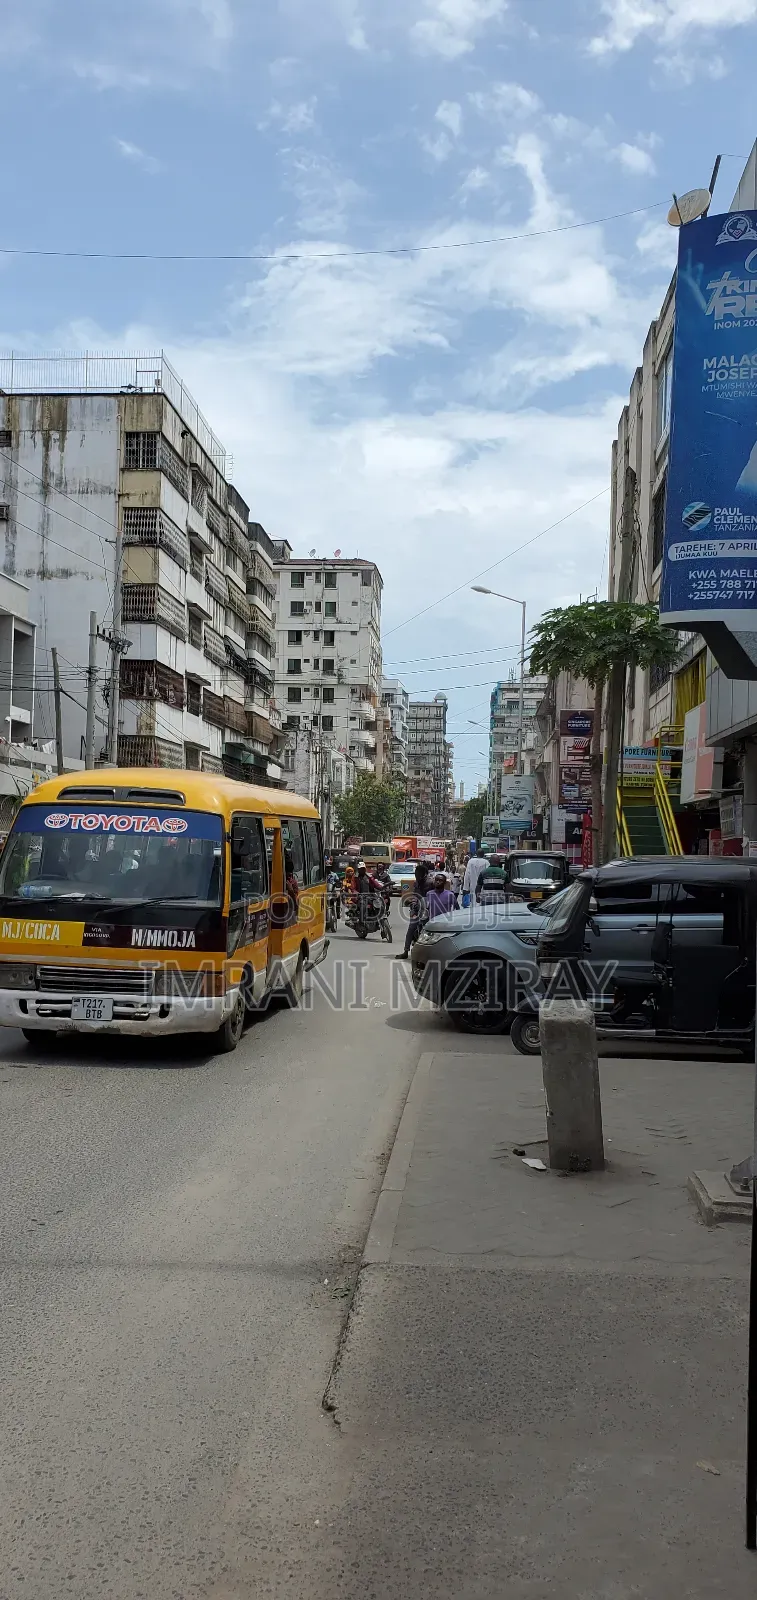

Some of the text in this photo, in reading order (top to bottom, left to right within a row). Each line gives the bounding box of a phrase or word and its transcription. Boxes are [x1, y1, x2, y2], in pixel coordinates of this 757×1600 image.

[714, 321, 741, 330] INOM
[701, 382, 745, 393] MTUMISHI
[714, 507, 742, 516] PAUL
[675, 543, 716, 554] TAREHE:
[719, 543, 726, 551] 7
[689, 570, 717, 580] KWA
[691, 579, 757, 589] +255 788 71
[687, 590, 756, 601] +255747 717
[69, 813, 163, 834] TOYOTA
[526, 830, 537, 838] LG
[85, 1009, 103, 1019] BTB
